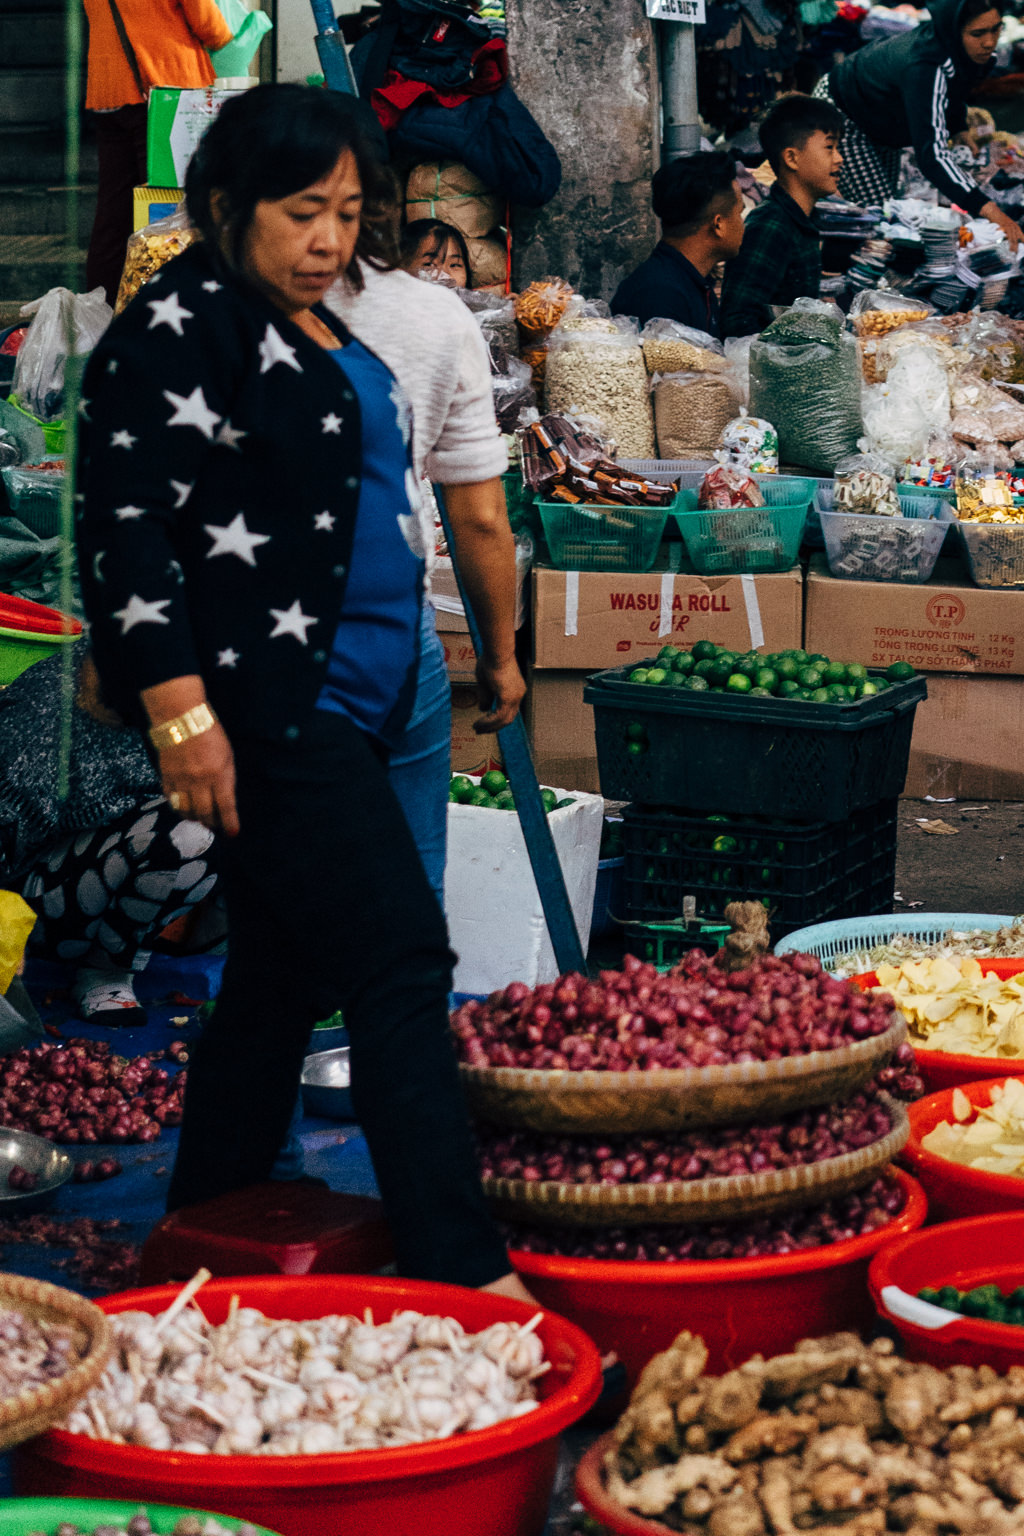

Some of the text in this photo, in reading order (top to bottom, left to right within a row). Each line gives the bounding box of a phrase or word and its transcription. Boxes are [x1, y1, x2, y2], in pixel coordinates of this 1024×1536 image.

[610, 593, 731, 612] WASUA ROLL
[933, 605, 959, 618] T.P
[649, 614, 690, 632] JR
[989, 634, 999, 643] 12
[1001, 635, 1015, 644] Kg
[872, 653, 886, 662] SX
